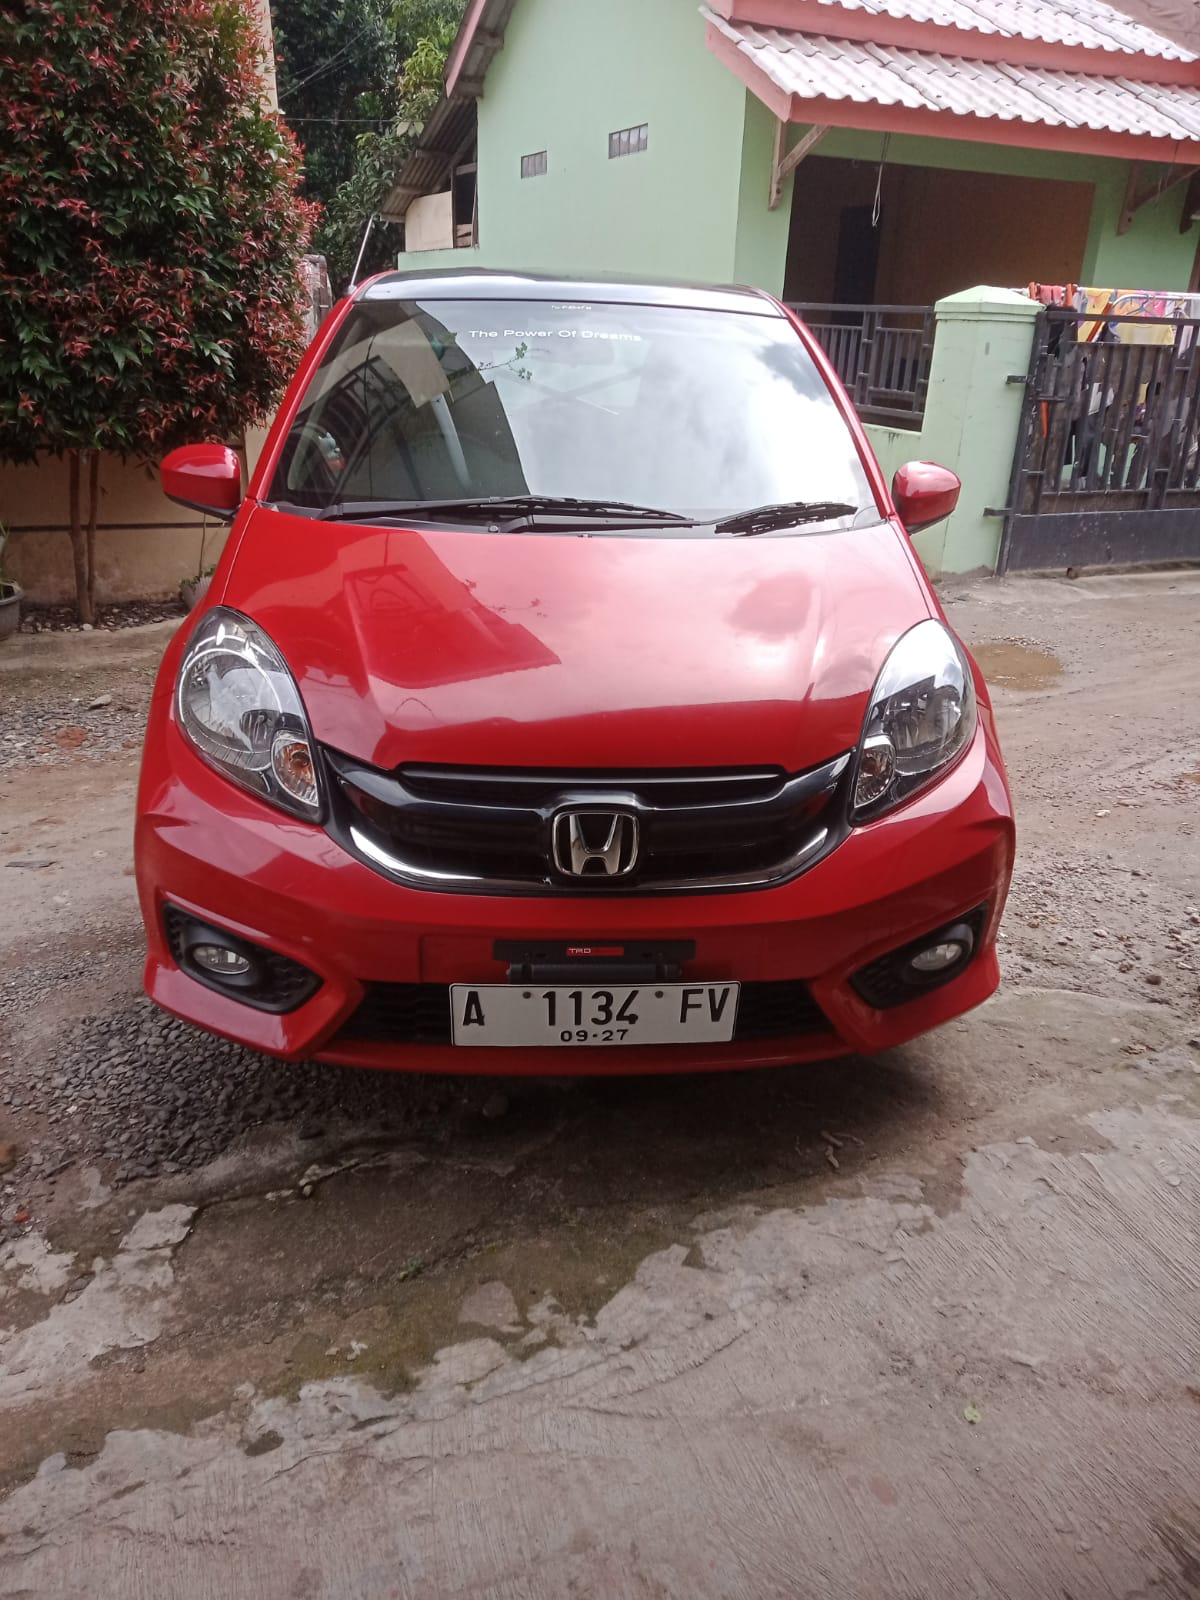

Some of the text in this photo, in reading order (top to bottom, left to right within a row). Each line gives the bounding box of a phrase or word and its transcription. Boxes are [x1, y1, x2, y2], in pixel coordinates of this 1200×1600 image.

[468, 329, 642, 342] The Power Of Dreams
[462, 987, 731, 1027] A 1134 FV
